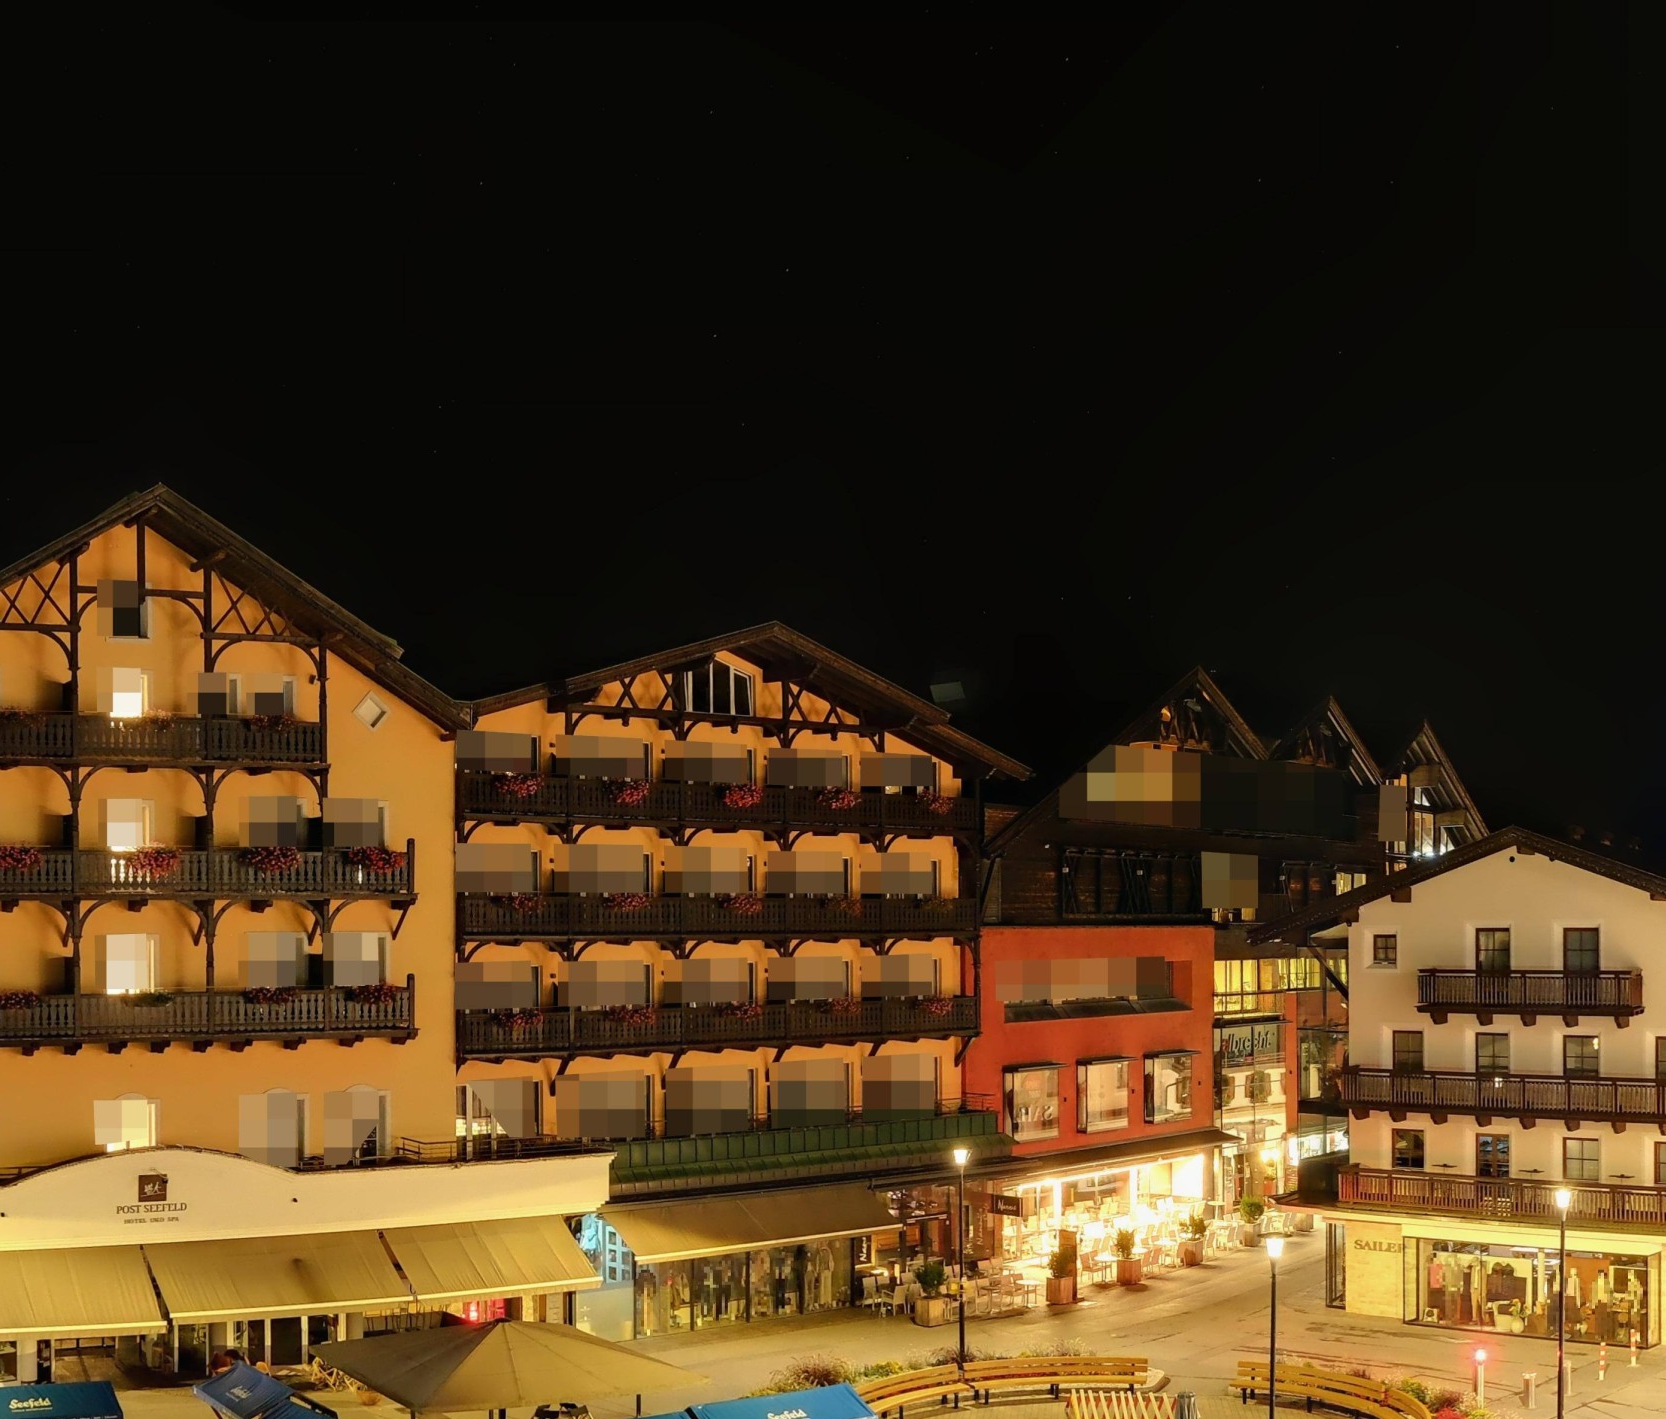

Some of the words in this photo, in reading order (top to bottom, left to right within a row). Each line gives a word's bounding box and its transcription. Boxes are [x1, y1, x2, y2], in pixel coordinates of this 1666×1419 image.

[116, 1204, 141, 1214] POST
[143, 1202, 187, 1213] SEEFELD
[8, 1397, 52, 1410] Seefeld
